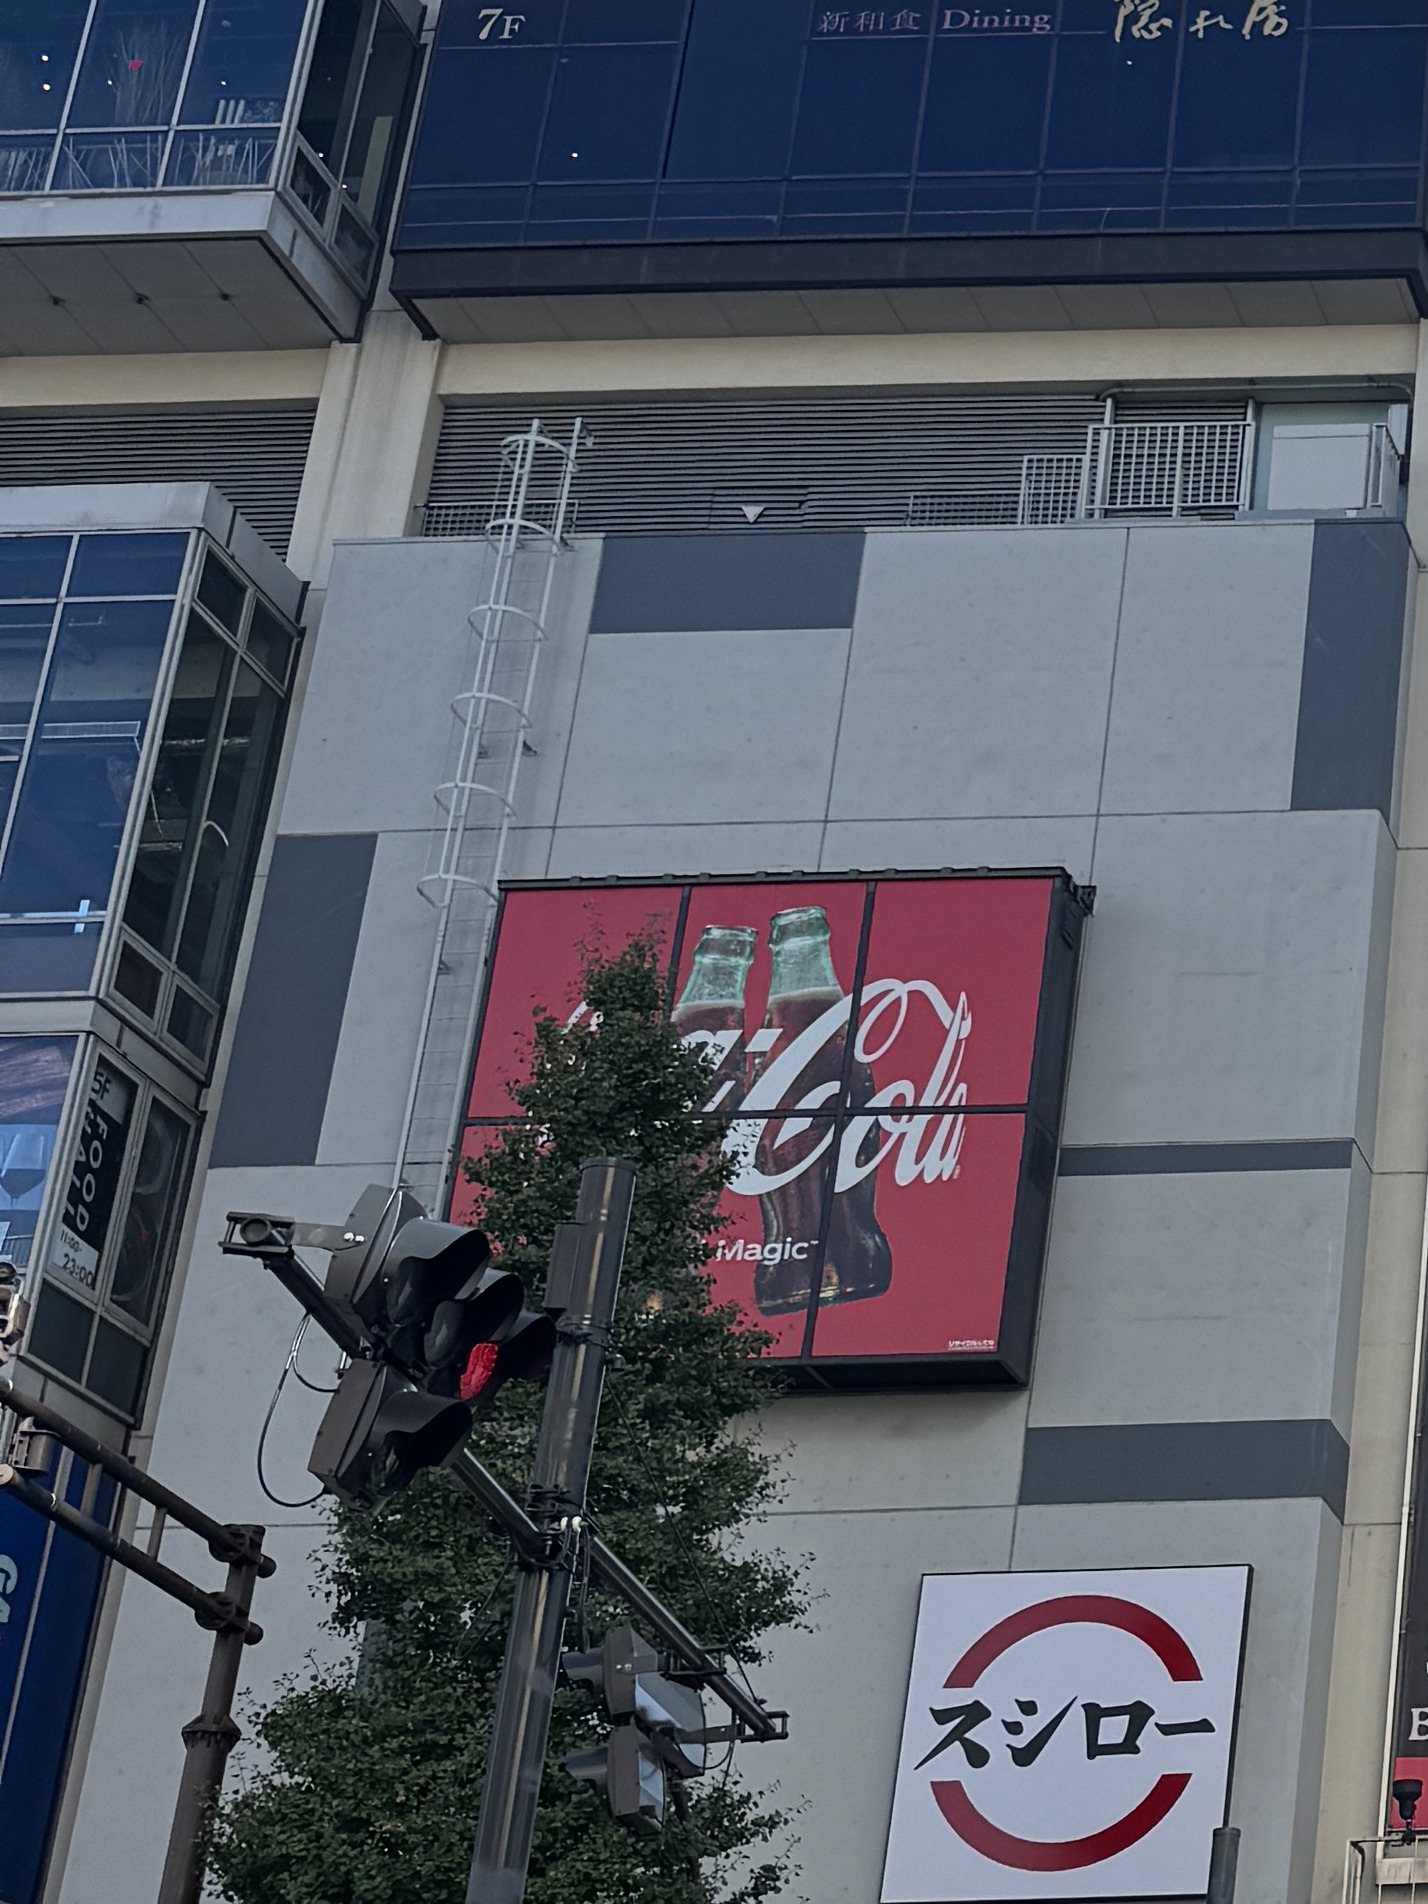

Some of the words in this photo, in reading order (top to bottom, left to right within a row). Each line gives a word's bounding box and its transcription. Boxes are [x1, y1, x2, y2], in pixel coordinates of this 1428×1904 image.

[476, 9, 527, 42] 7F
[942, 8, 1052, 33] Dining
[914, 1696, 1215, 1771] スシロー
